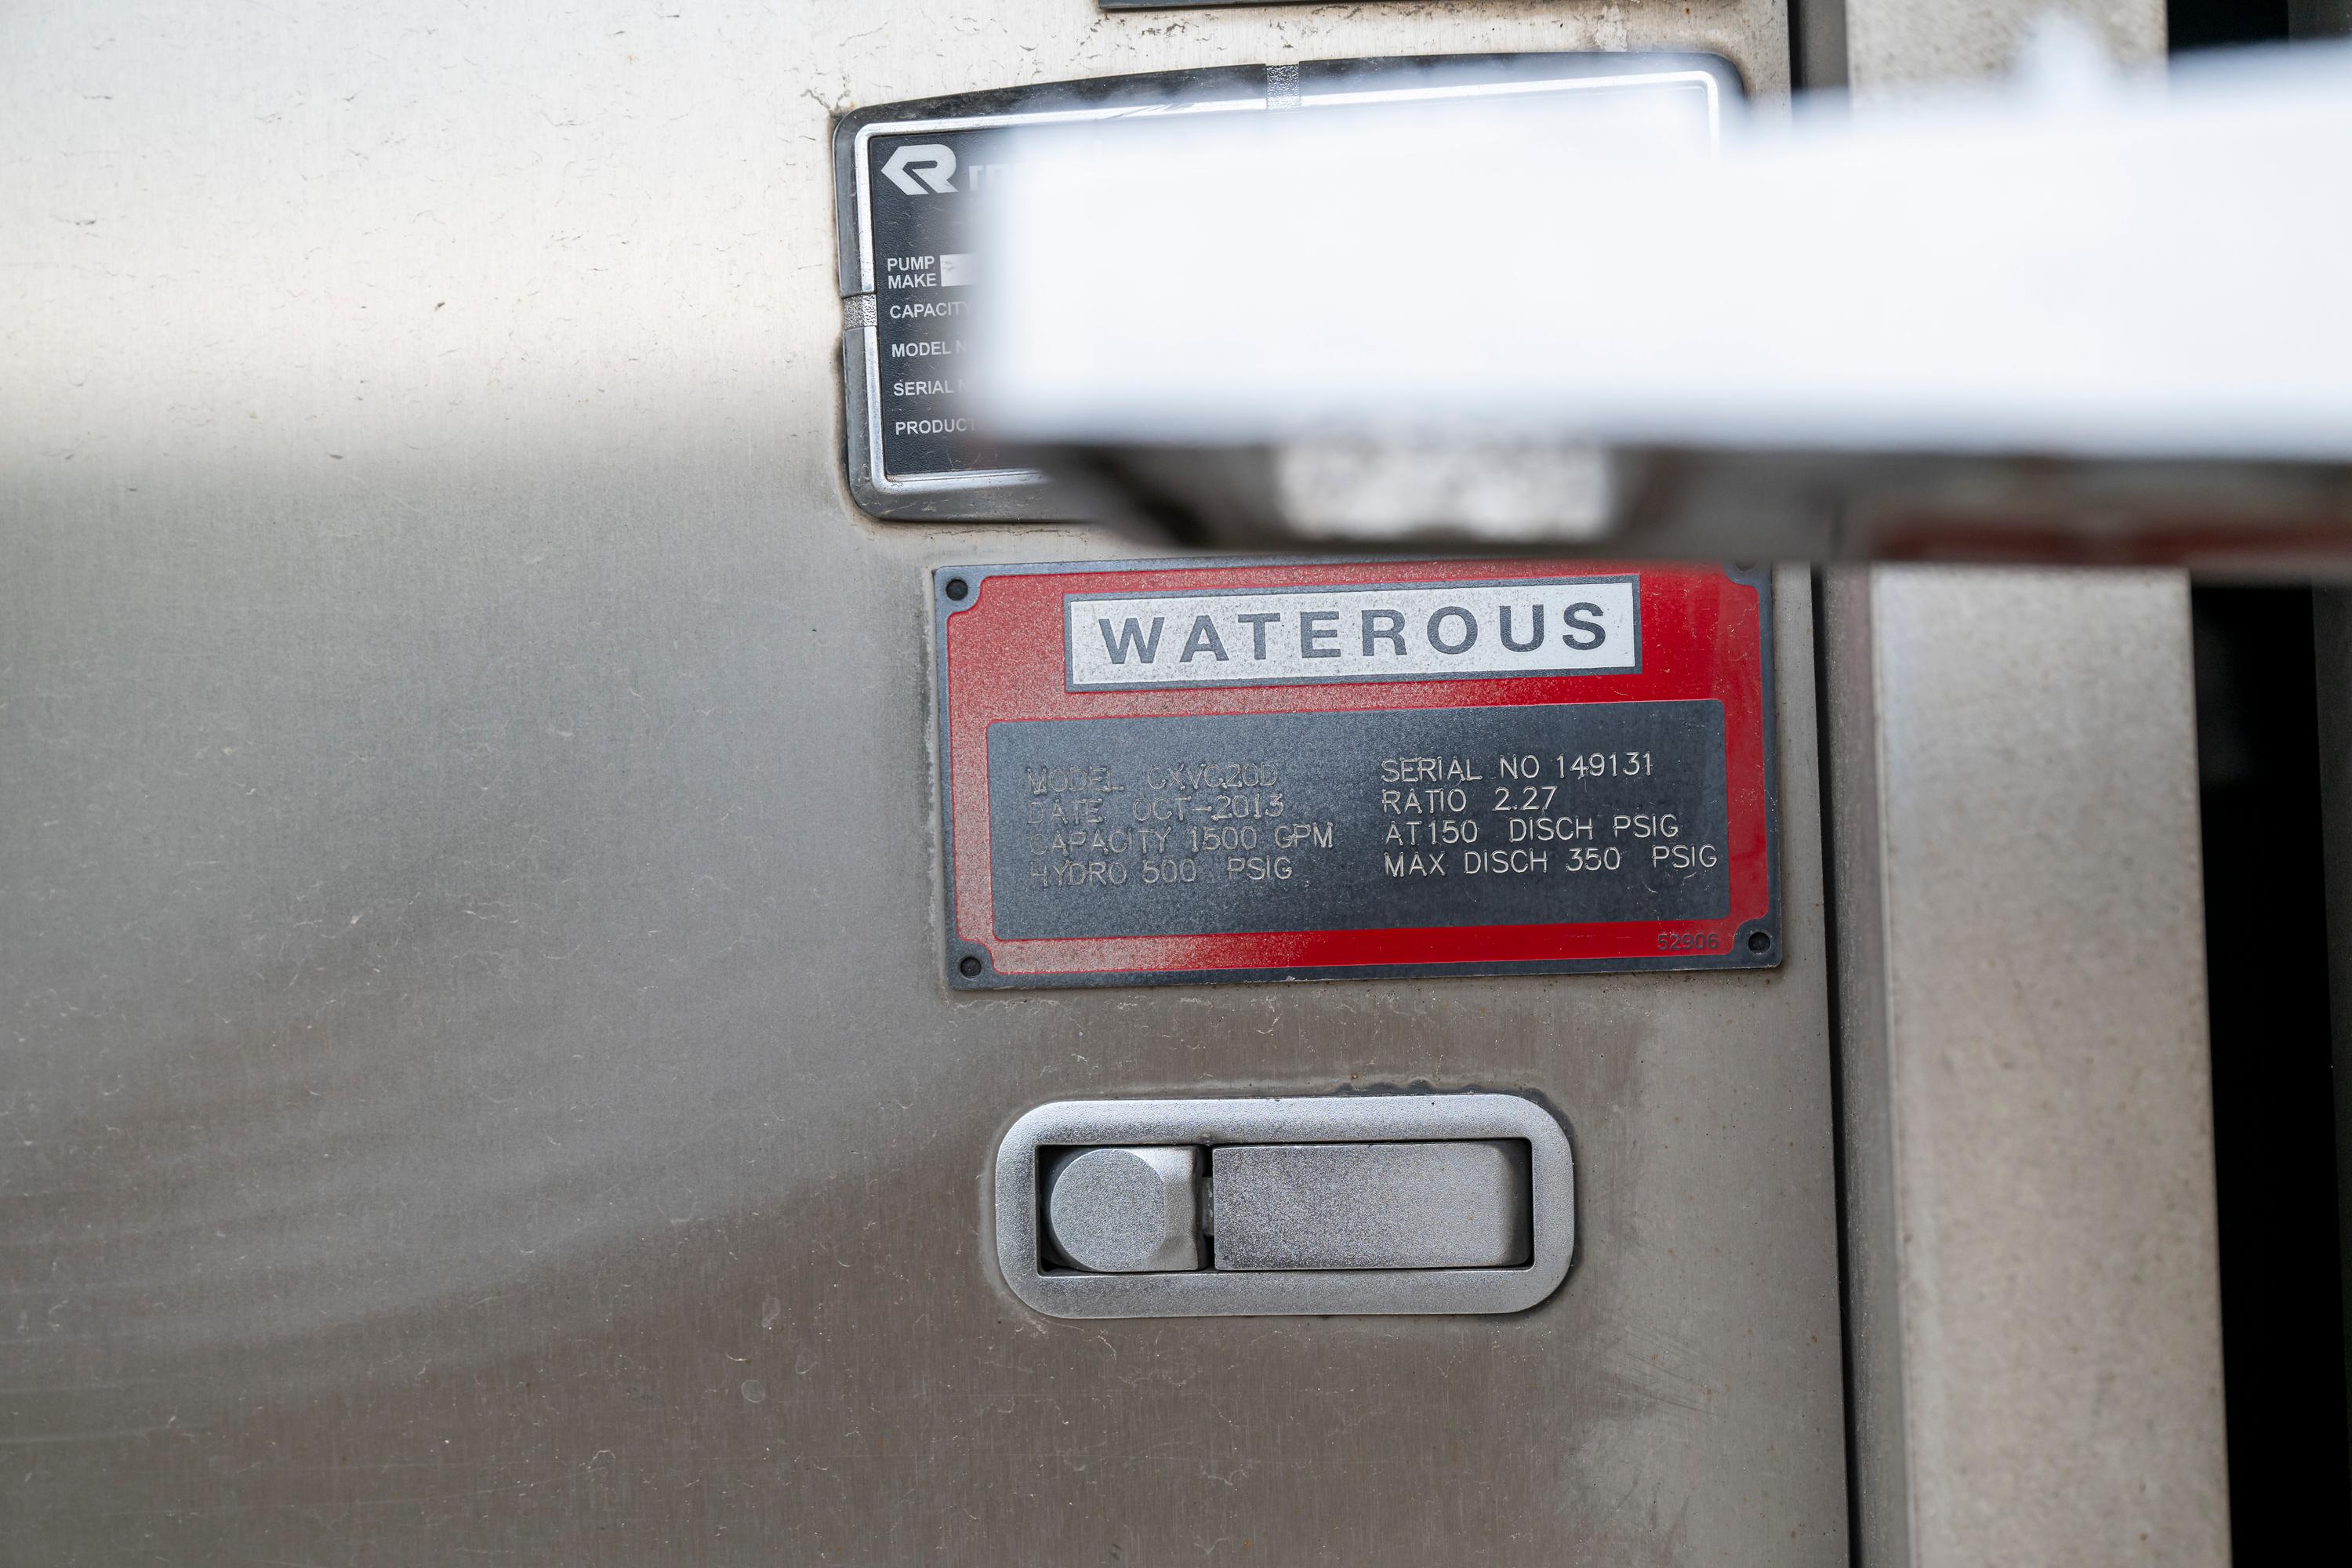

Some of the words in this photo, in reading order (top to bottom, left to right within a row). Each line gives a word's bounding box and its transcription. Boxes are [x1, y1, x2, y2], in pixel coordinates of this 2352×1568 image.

[887, 256, 935, 271] PUMP
[888, 273, 937, 289] MAKE
[889, 301, 973, 318] CAPACITY
[891, 342, 952, 358] MODEL
[894, 380, 954, 396] SERIAL
[1099, 601, 1606, 665] WATEROUS
[1028, 766, 1124, 795] MODEL
[1381, 756, 1483, 782] SERIAL
[1499, 753, 1541, 780] NO
[1556, 750, 1653, 779] 149131
[1028, 798, 1103, 823] DATE
[1132, 793, 1284, 821] OCT-2013
[1382, 789, 1467, 815] RATIO
[1492, 785, 1558, 811] 2.27
[1029, 826, 1172, 857] CAPACITY
[1191, 826, 1258, 853] 1500
[1274, 822, 1334, 848] GPM
[1508, 816, 1594, 843] DISCH
[1613, 813, 1679, 839] PSIG
[1030, 859, 1127, 887] HYDRO
[1142, 858, 1196, 884] 500
[1227, 855, 1292, 880] PSIG
[1383, 851, 1446, 877] MAX
[1464, 848, 1548, 874] DISCH
[1566, 845, 1621, 872] 350
[1652, 844, 1718, 869] PSIG
[1657, 932, 1719, 951] 52906
